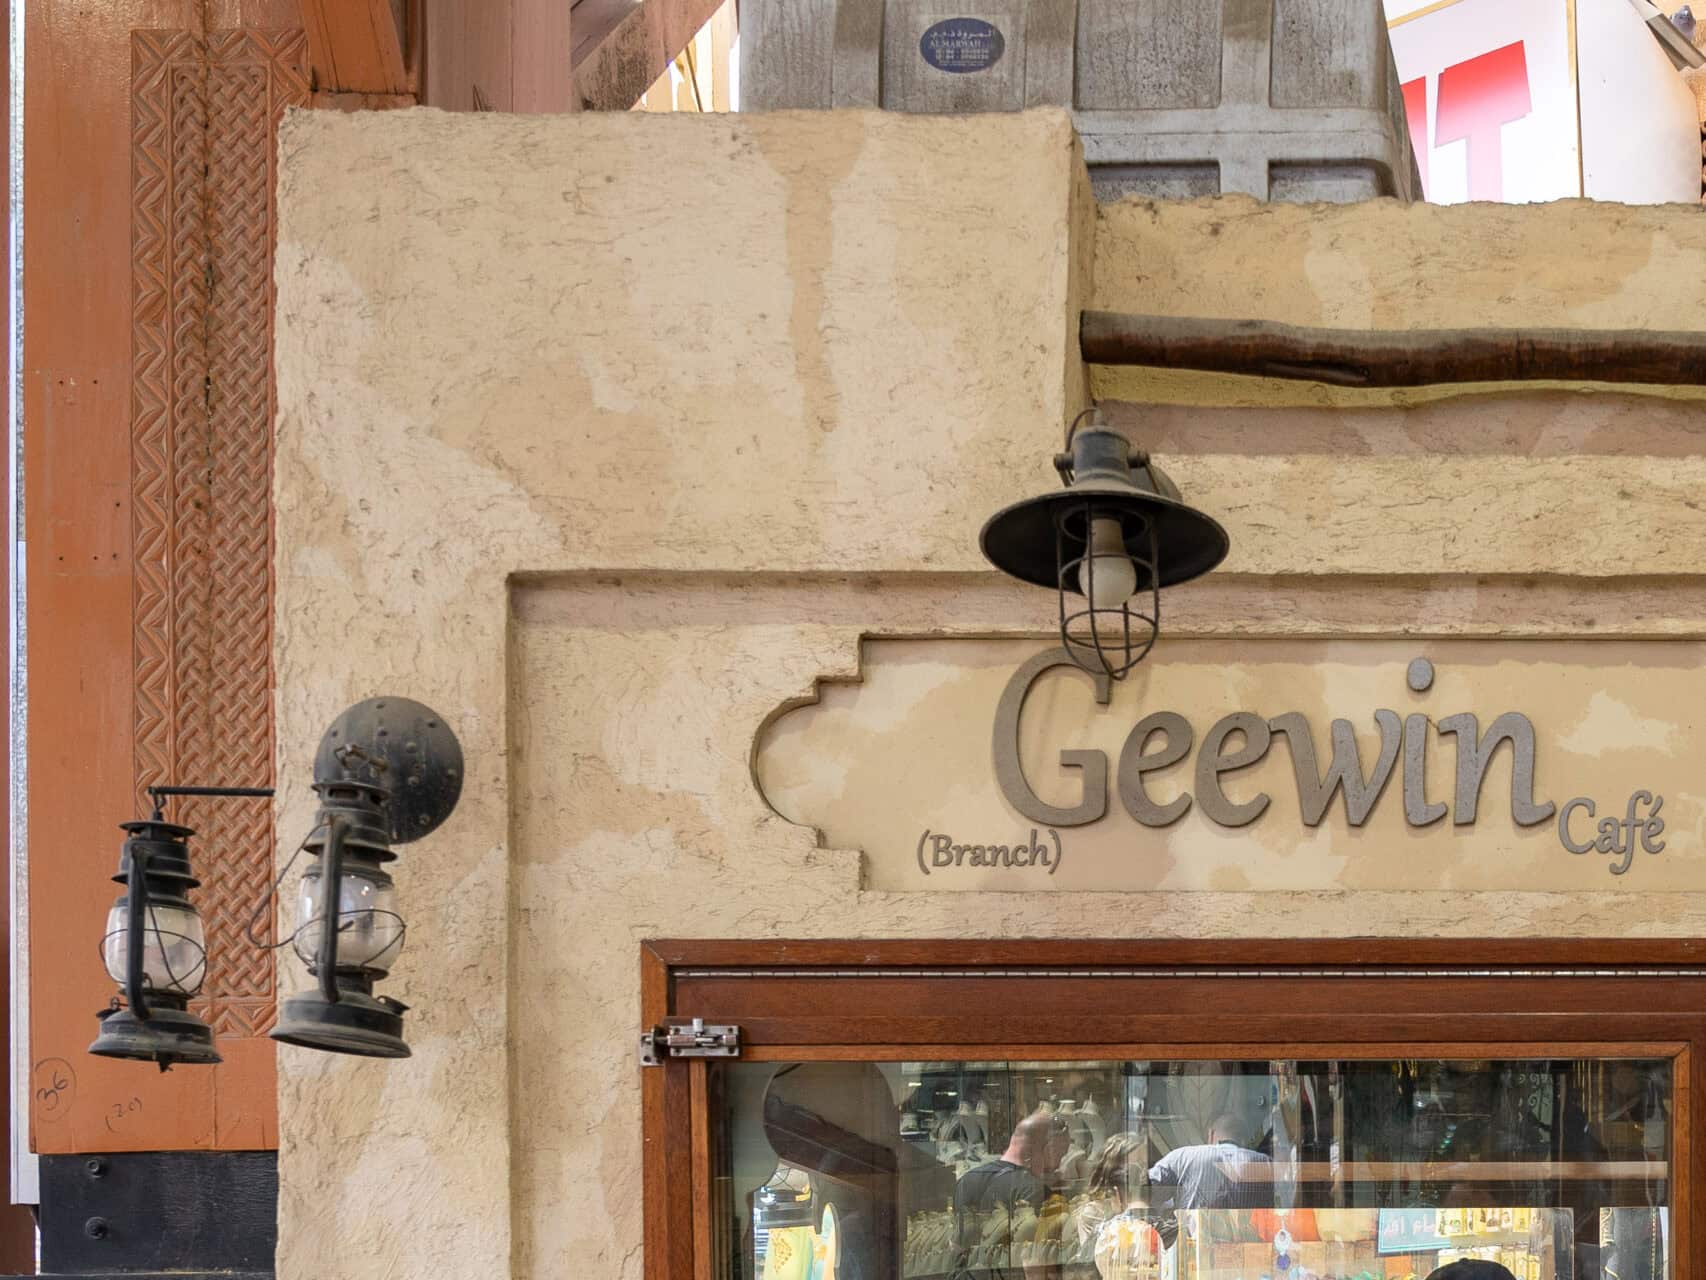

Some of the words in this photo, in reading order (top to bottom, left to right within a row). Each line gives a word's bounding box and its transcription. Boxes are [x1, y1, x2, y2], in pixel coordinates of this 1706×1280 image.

[992, 645, 1557, 830] Geewin
[1557, 790, 1667, 876] Café
[916, 829, 1062, 875] (Branch)
